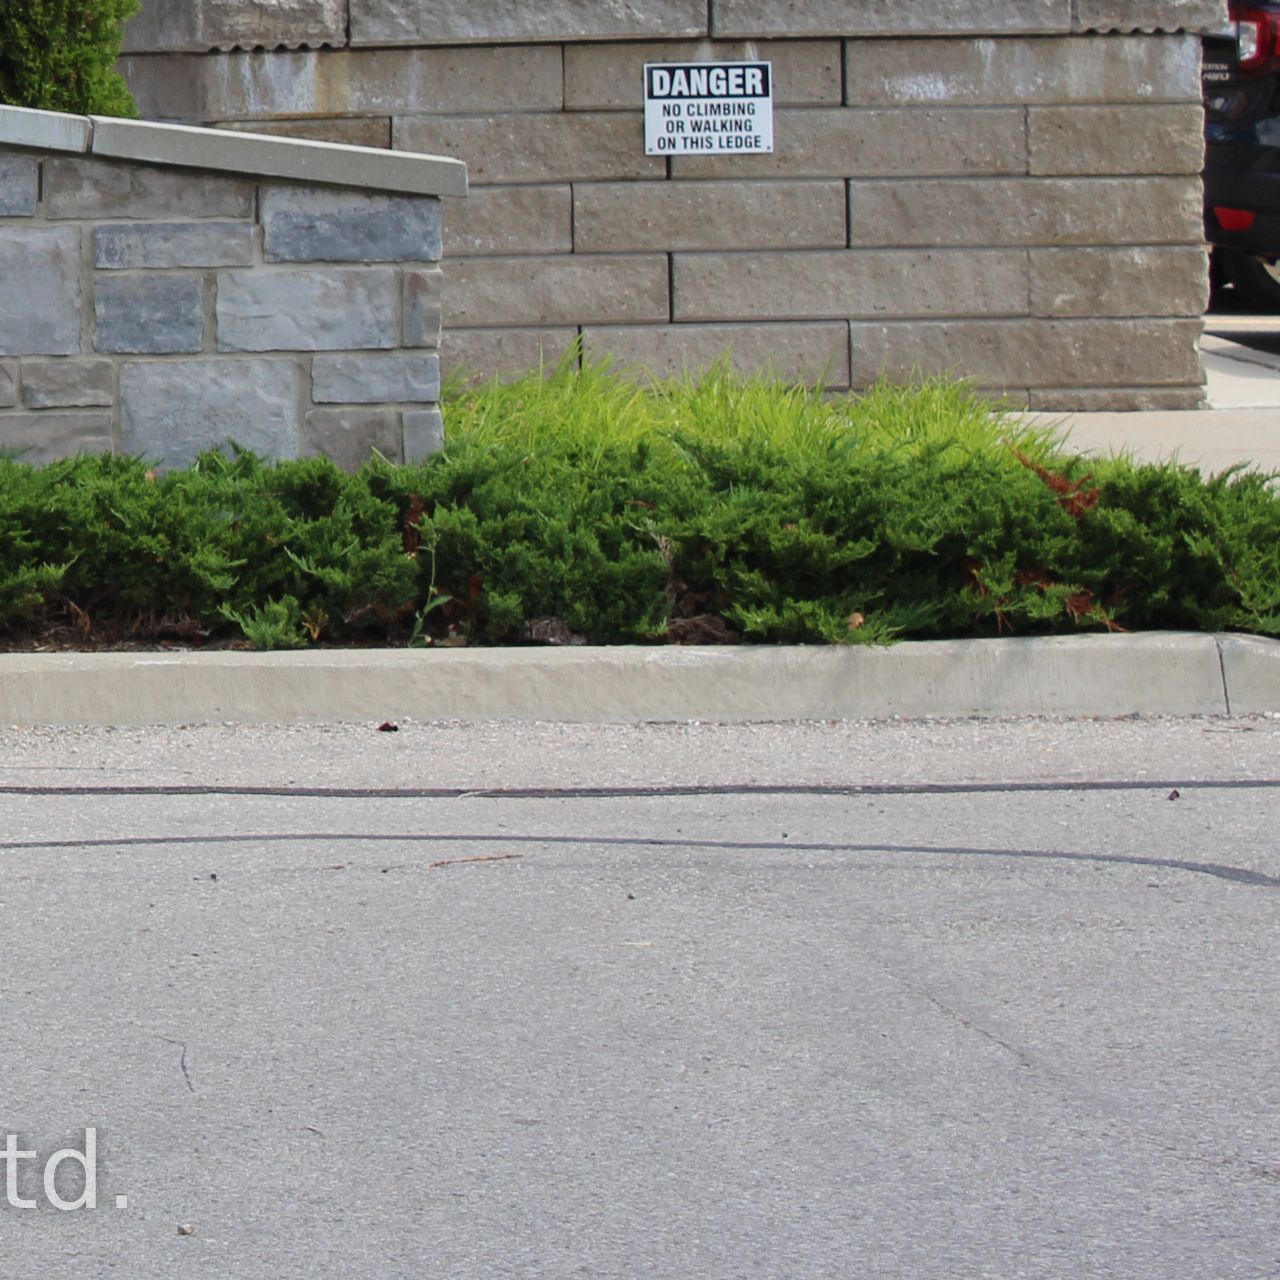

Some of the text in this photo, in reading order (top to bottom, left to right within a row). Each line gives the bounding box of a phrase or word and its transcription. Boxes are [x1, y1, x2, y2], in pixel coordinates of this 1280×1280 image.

[652, 67, 764, 97] DANGER
[662, 102, 756, 117] NO CLIMBING
[666, 119, 753, 133] OR WALKING
[657, 135, 762, 150] ON THIS LEDGE
